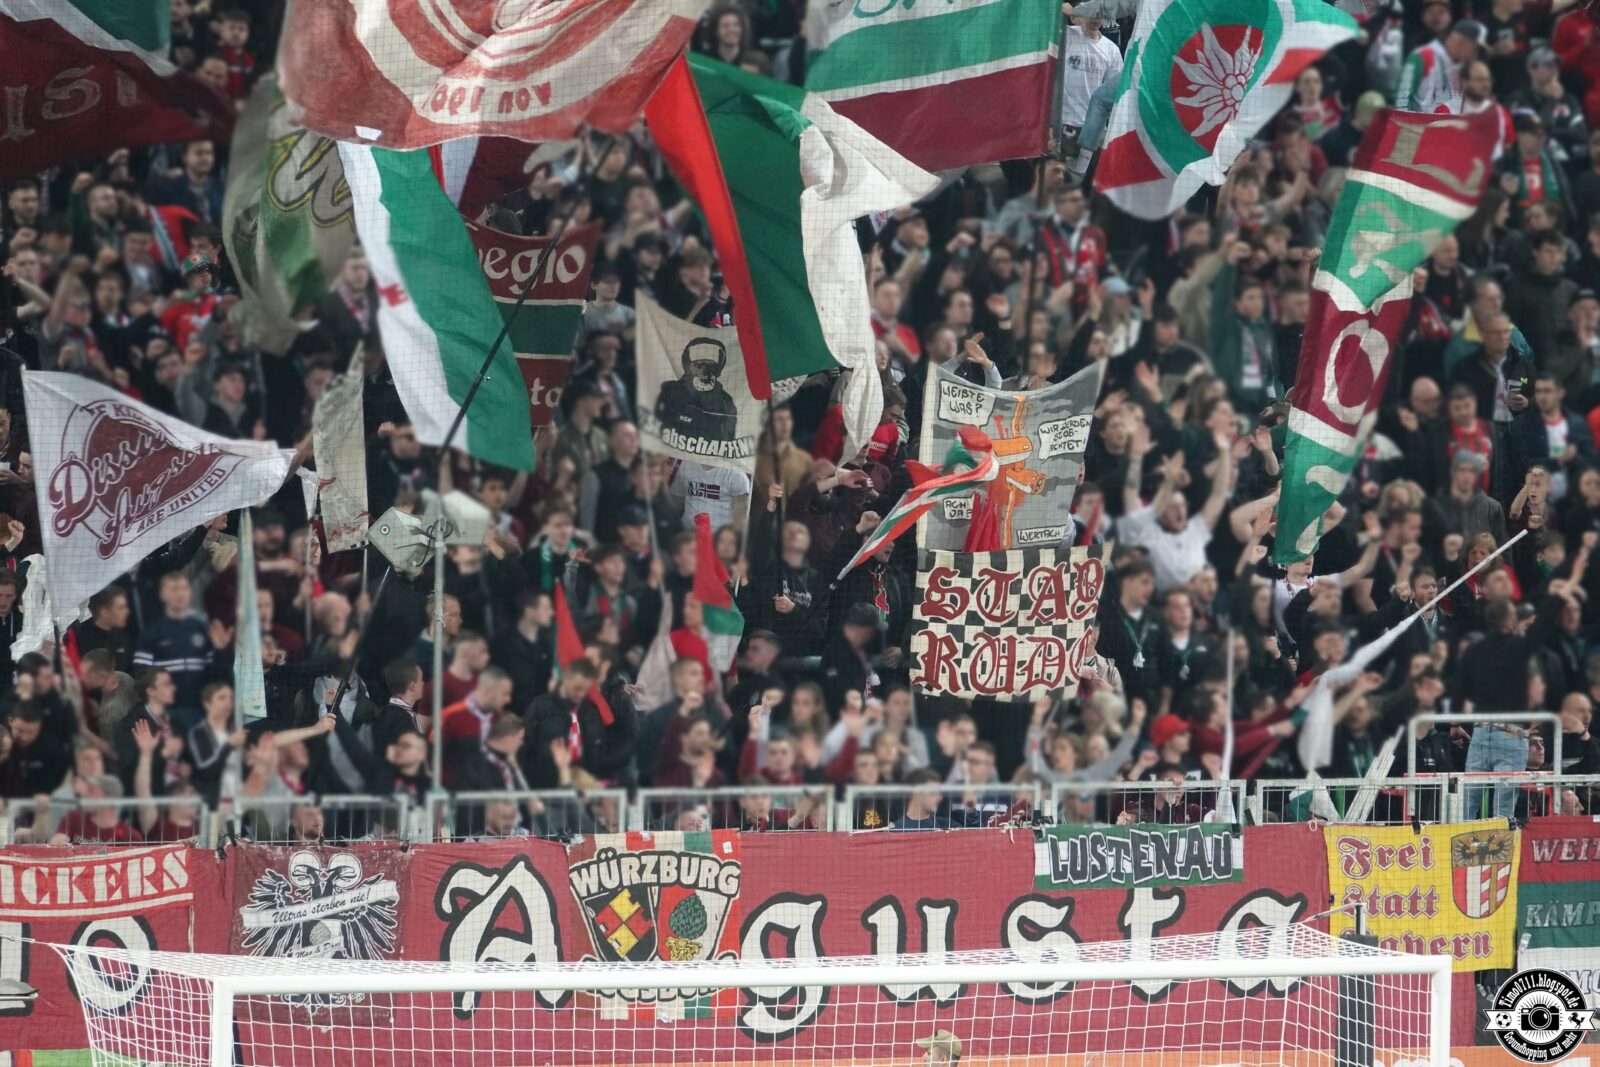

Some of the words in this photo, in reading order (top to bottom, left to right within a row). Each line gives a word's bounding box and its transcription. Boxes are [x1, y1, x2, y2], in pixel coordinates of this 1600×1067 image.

[477, 245, 586, 294] egio
[138, 509, 166, 533] ARE
[169, 467, 226, 512] UNITED
[945, 501, 967, 510] ACH
[1020, 529, 1060, 542] WERTACH
[920, 558, 1105, 624] STAY
[0, 850, 189, 905] ICKERS
[569, 848, 742, 898] WÜRZBURG
[1048, 825, 1233, 884] LUSTENAU
[1336, 835, 1436, 880] Frei
[271, 907, 308, 924] Ultras
[311, 897, 347, 914] sterben
[351, 887, 371, 905] nie!
[1341, 884, 1441, 919] Statt
[434, 856, 1310, 1042] Agusta
[1341, 928, 1494, 961] ayern
